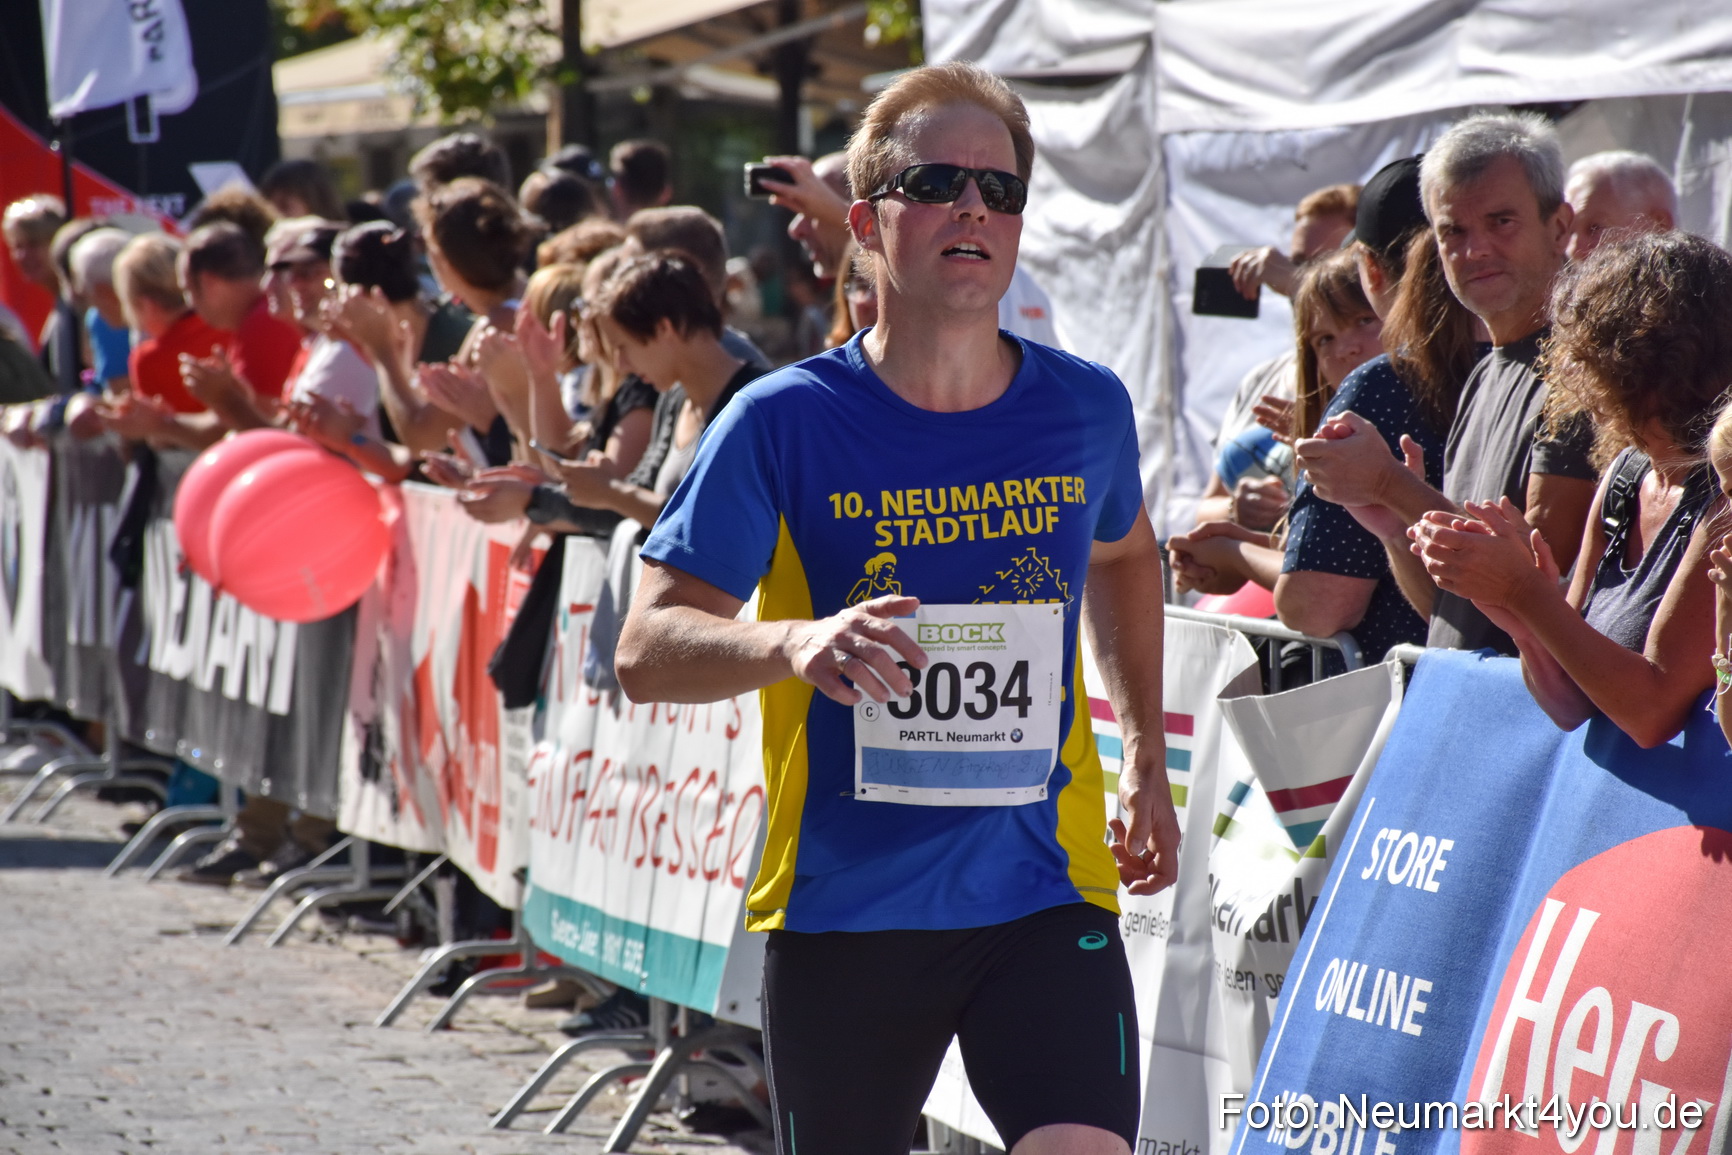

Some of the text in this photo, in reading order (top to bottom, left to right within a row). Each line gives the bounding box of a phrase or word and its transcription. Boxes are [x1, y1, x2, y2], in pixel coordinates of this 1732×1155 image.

[828, 476, 1086, 519] 10. NEUMARKTER
[875, 506, 1059, 547] STADTLAUF
[918, 623, 1006, 643] BOCK
[887, 660, 1032, 720] 3034
[899, 730, 1006, 742] PARTL Neumarkt
[1361, 827, 1454, 893] STORE
[1315, 958, 1433, 1036] ONLINE
